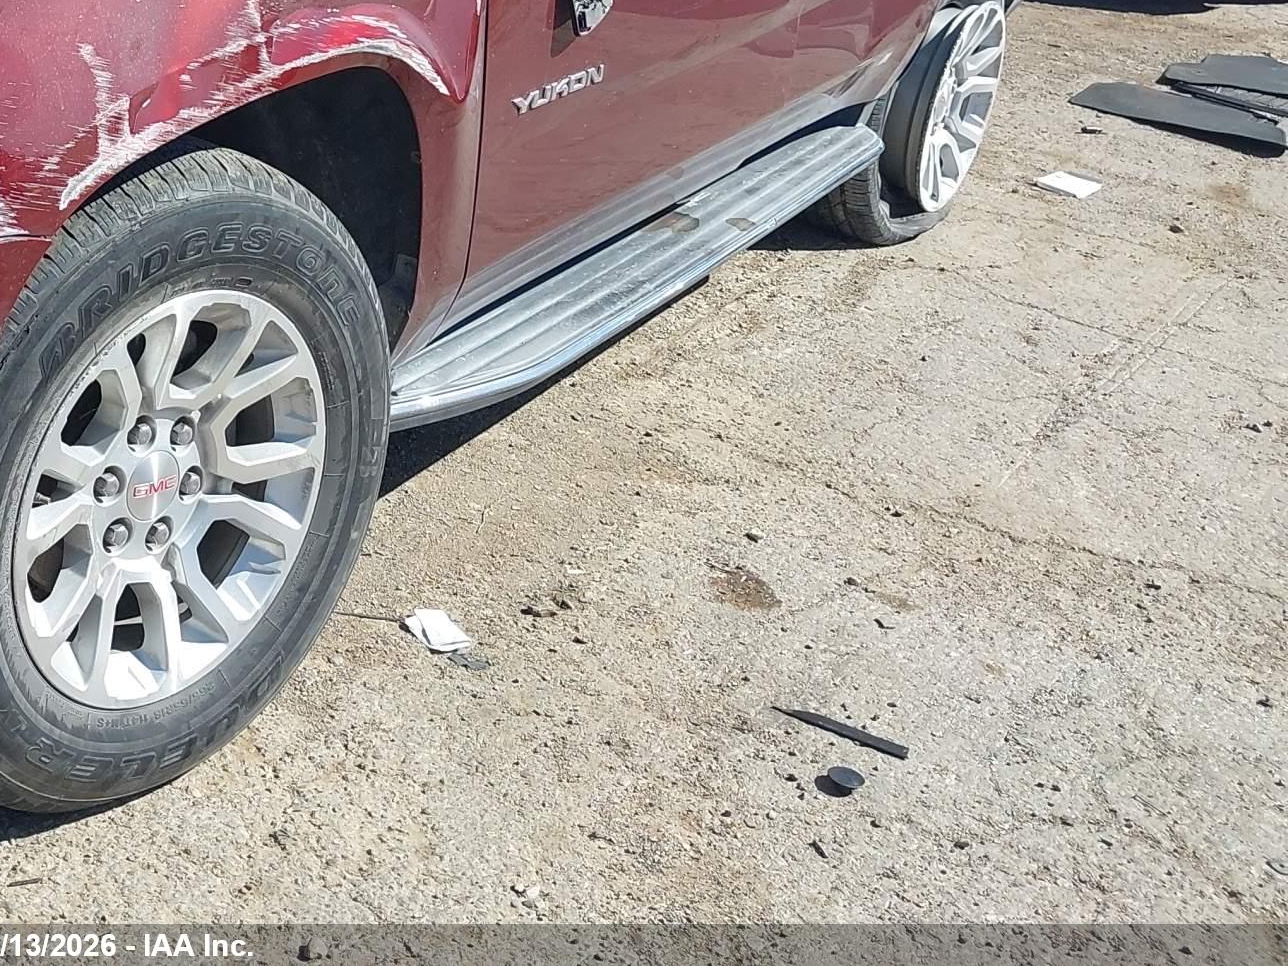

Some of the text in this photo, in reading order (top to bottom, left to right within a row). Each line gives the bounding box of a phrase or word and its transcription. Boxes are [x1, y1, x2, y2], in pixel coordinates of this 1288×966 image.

[511, 64, 605, 115] YUKON
[132, 475, 177, 499] GMC
[24, 653, 285, 782] DUELER
